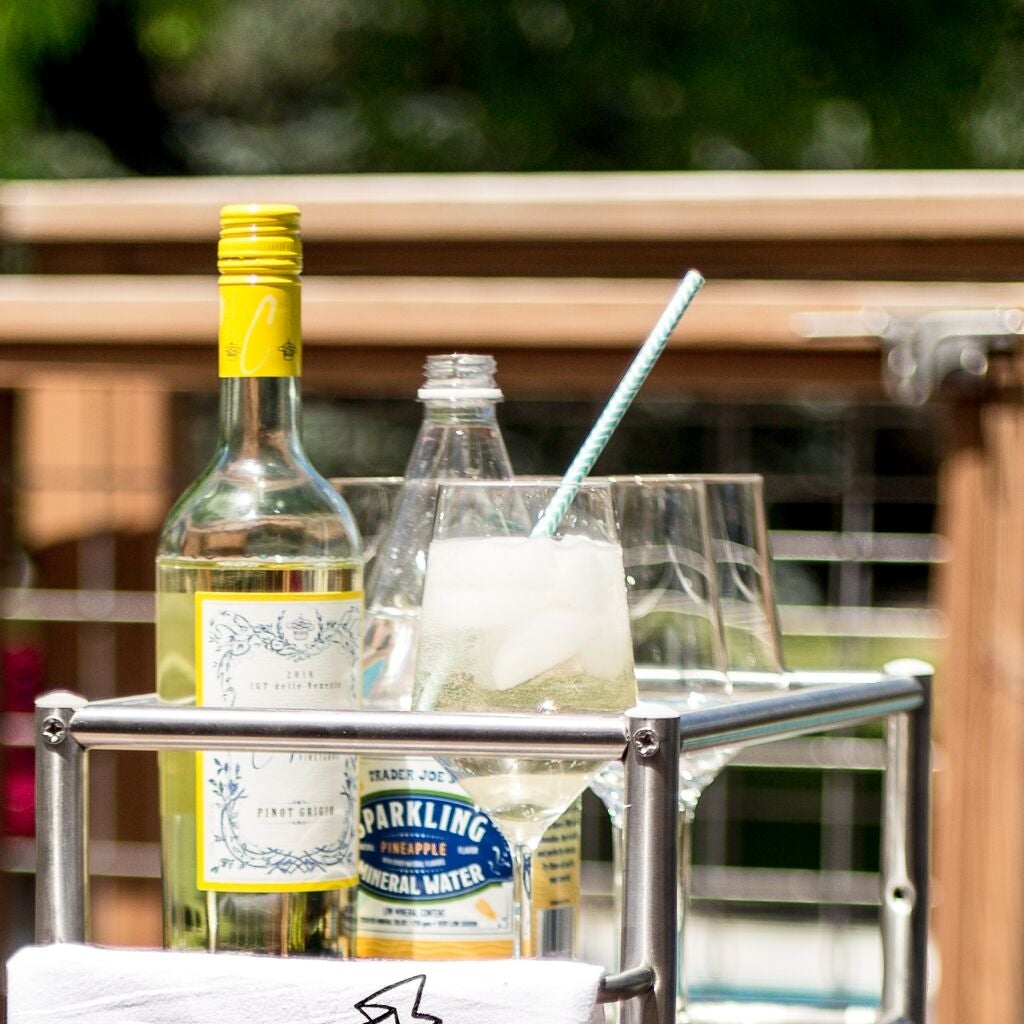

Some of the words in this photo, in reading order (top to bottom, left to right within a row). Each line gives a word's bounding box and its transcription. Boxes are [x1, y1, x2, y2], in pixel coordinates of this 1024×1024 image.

[368, 768, 413, 781] TRADER
[257, 807, 293, 818] PINOT
[380, 841, 447, 856] PINEAPPLE
[359, 860, 421, 895] MINERAL
[422, 863, 485, 895] WATER
